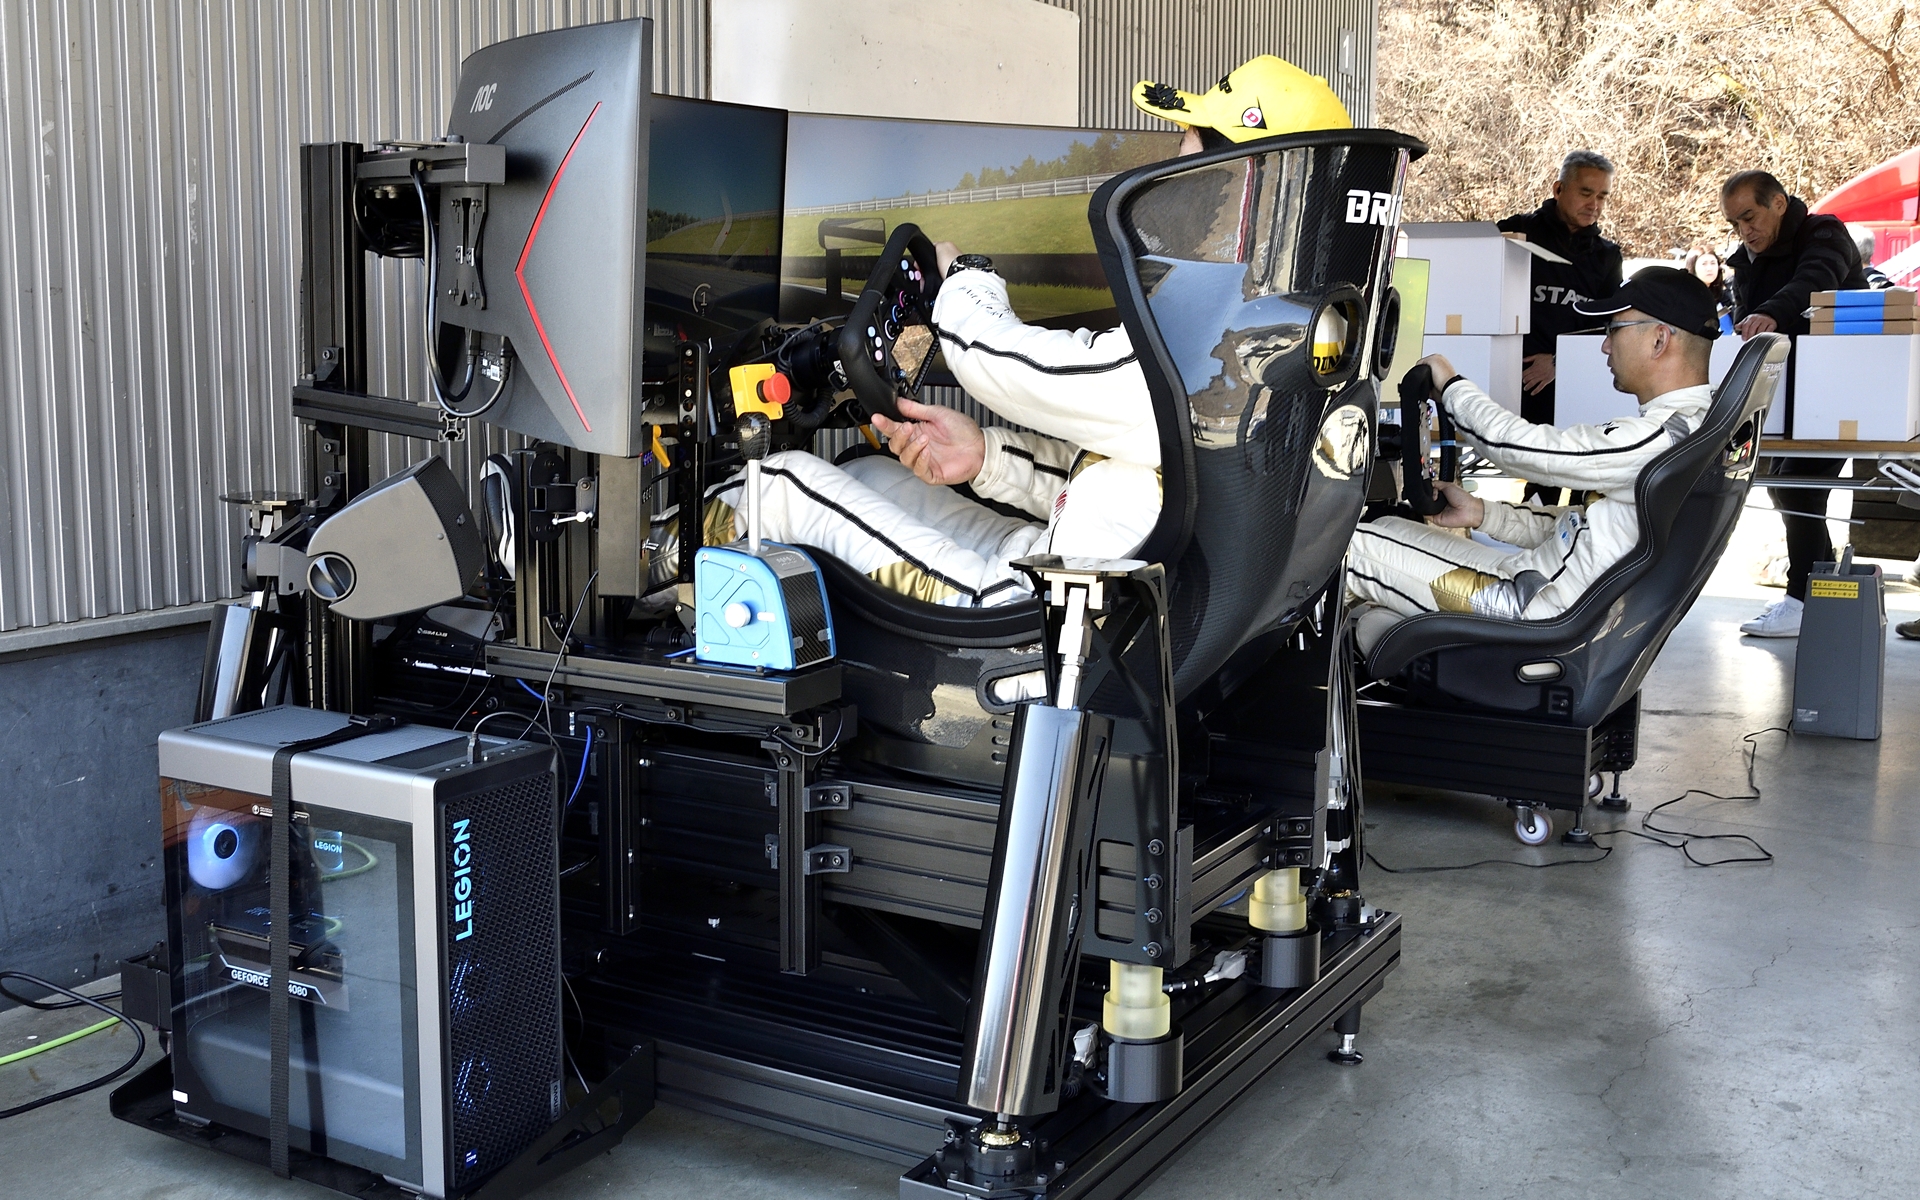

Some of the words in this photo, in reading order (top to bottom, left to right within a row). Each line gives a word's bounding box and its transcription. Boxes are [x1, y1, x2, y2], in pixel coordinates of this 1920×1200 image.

[1342, 34, 1350, 69] 1
[469, 82, 498, 114] AOC
[1345, 189, 1403, 227] BRI
[700, 291, 708, 306] 1
[1533, 284, 1595, 305] STA
[314, 840, 342, 854] LEGION
[453, 818, 473, 942] LEGION
[231, 969, 269, 988] GEFORCE
[288, 983, 308, 997] 4080
